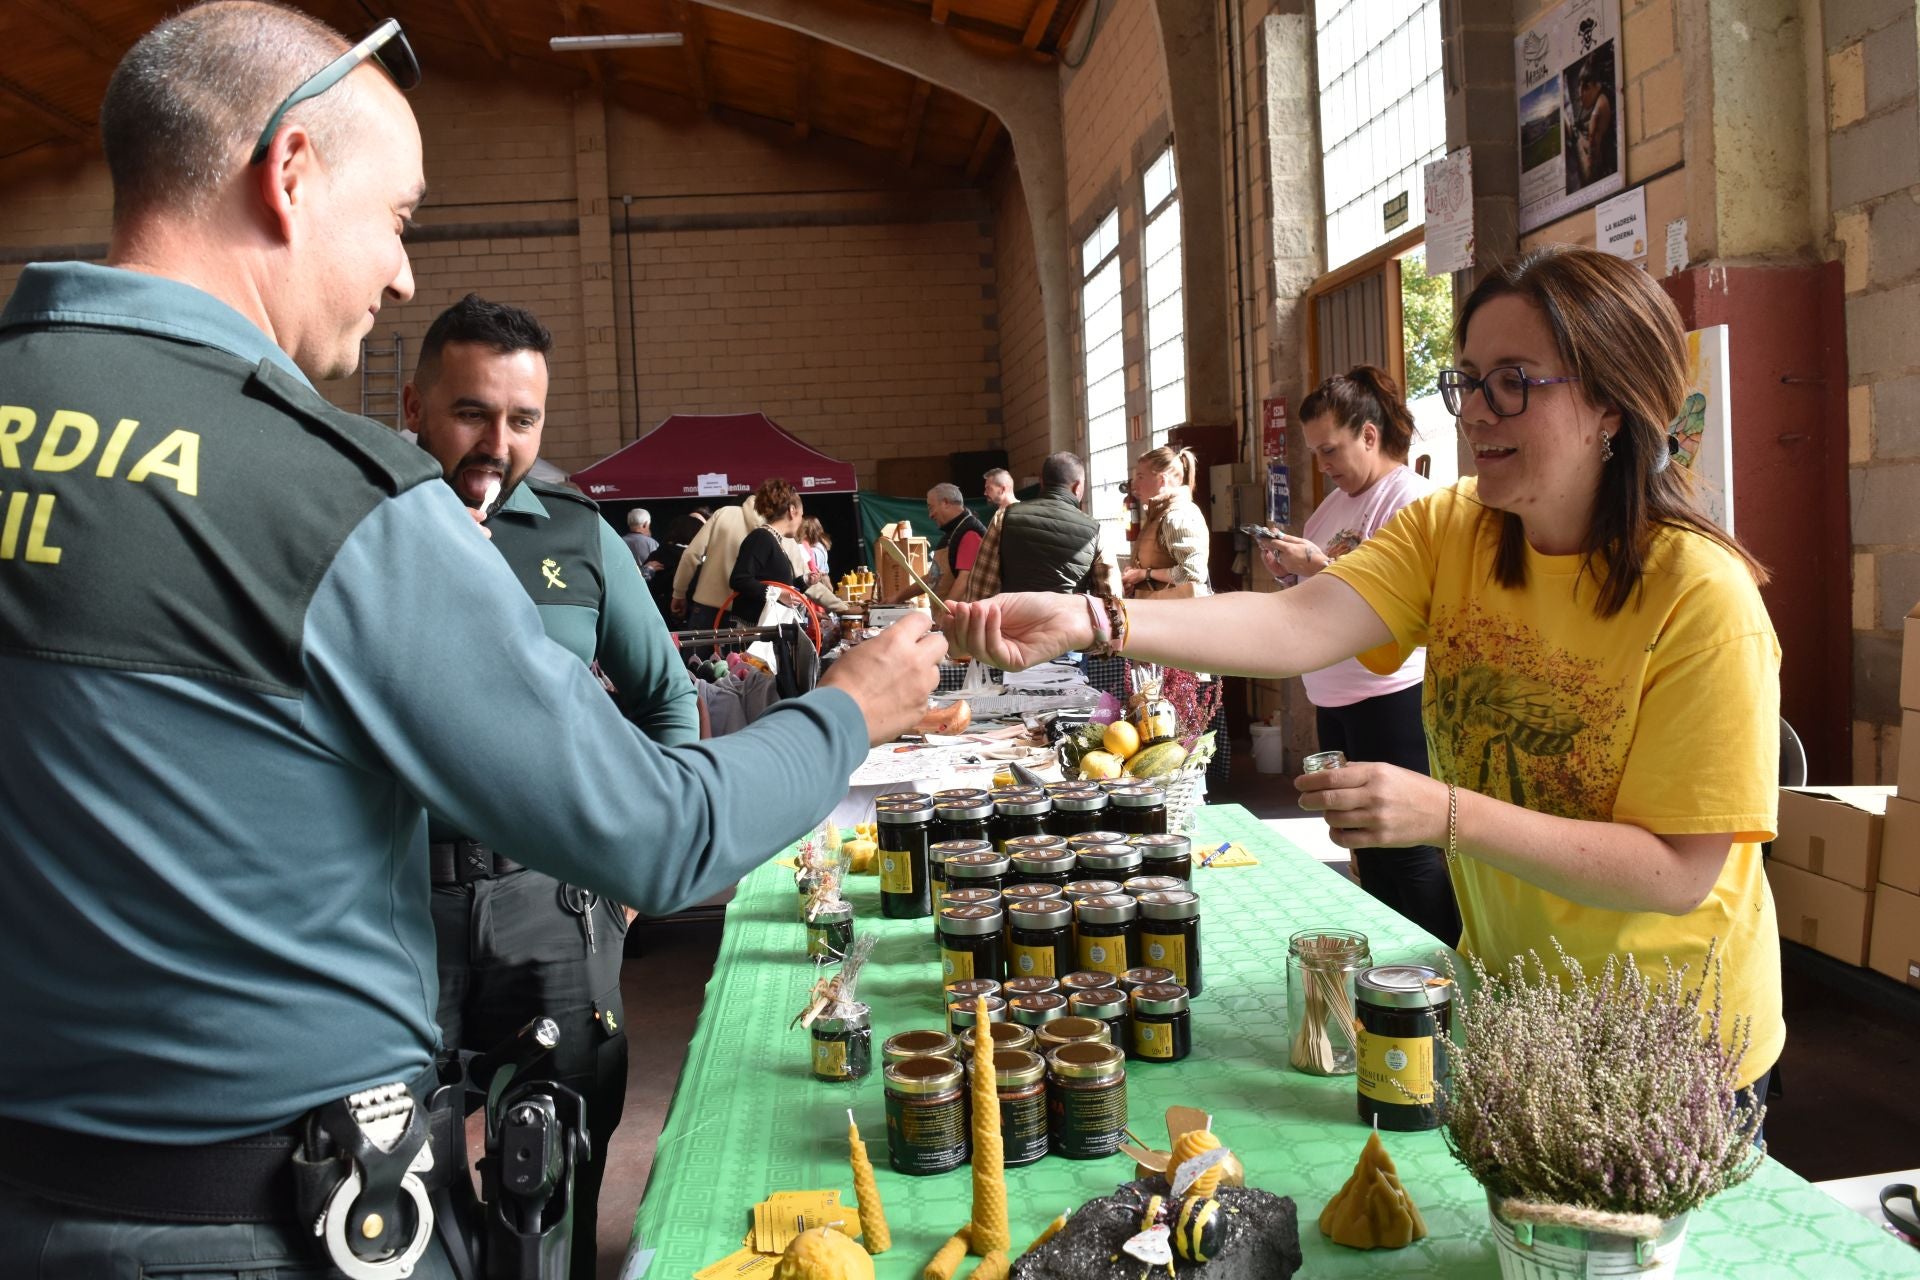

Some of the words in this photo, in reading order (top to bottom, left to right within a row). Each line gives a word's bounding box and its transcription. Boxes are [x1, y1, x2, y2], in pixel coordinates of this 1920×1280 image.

[1604, 223, 1612, 232] LA
[1609, 229, 1634, 243] MODERNA
[728, 484, 750, 492] entina
[0, 491, 62, 565] IL
